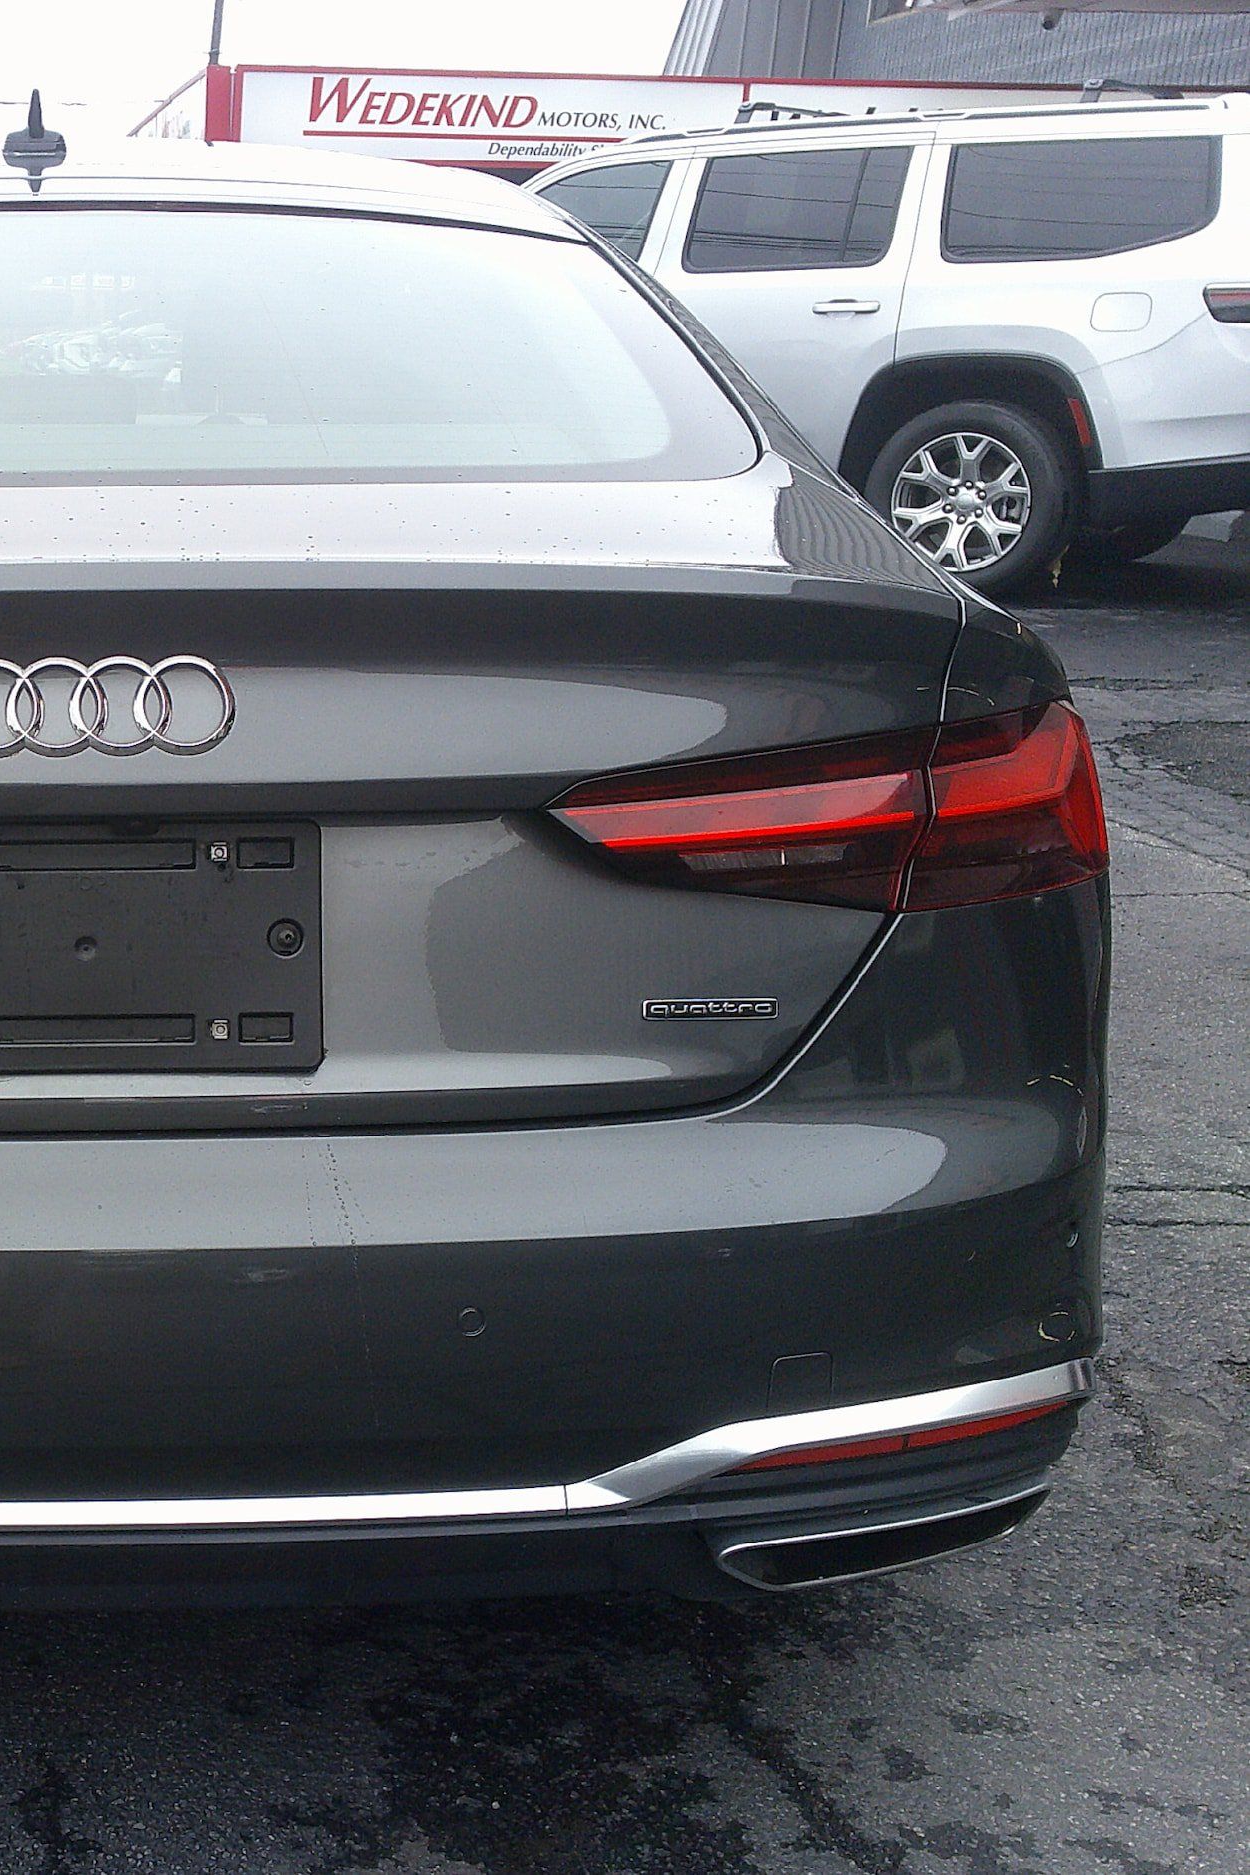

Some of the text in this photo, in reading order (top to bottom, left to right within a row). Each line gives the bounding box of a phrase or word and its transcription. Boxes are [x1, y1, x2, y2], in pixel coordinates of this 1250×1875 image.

[308, 77, 667, 132] WEDEKIND MOTORS, INC.
[649, 1002, 773, 1017] quattro
